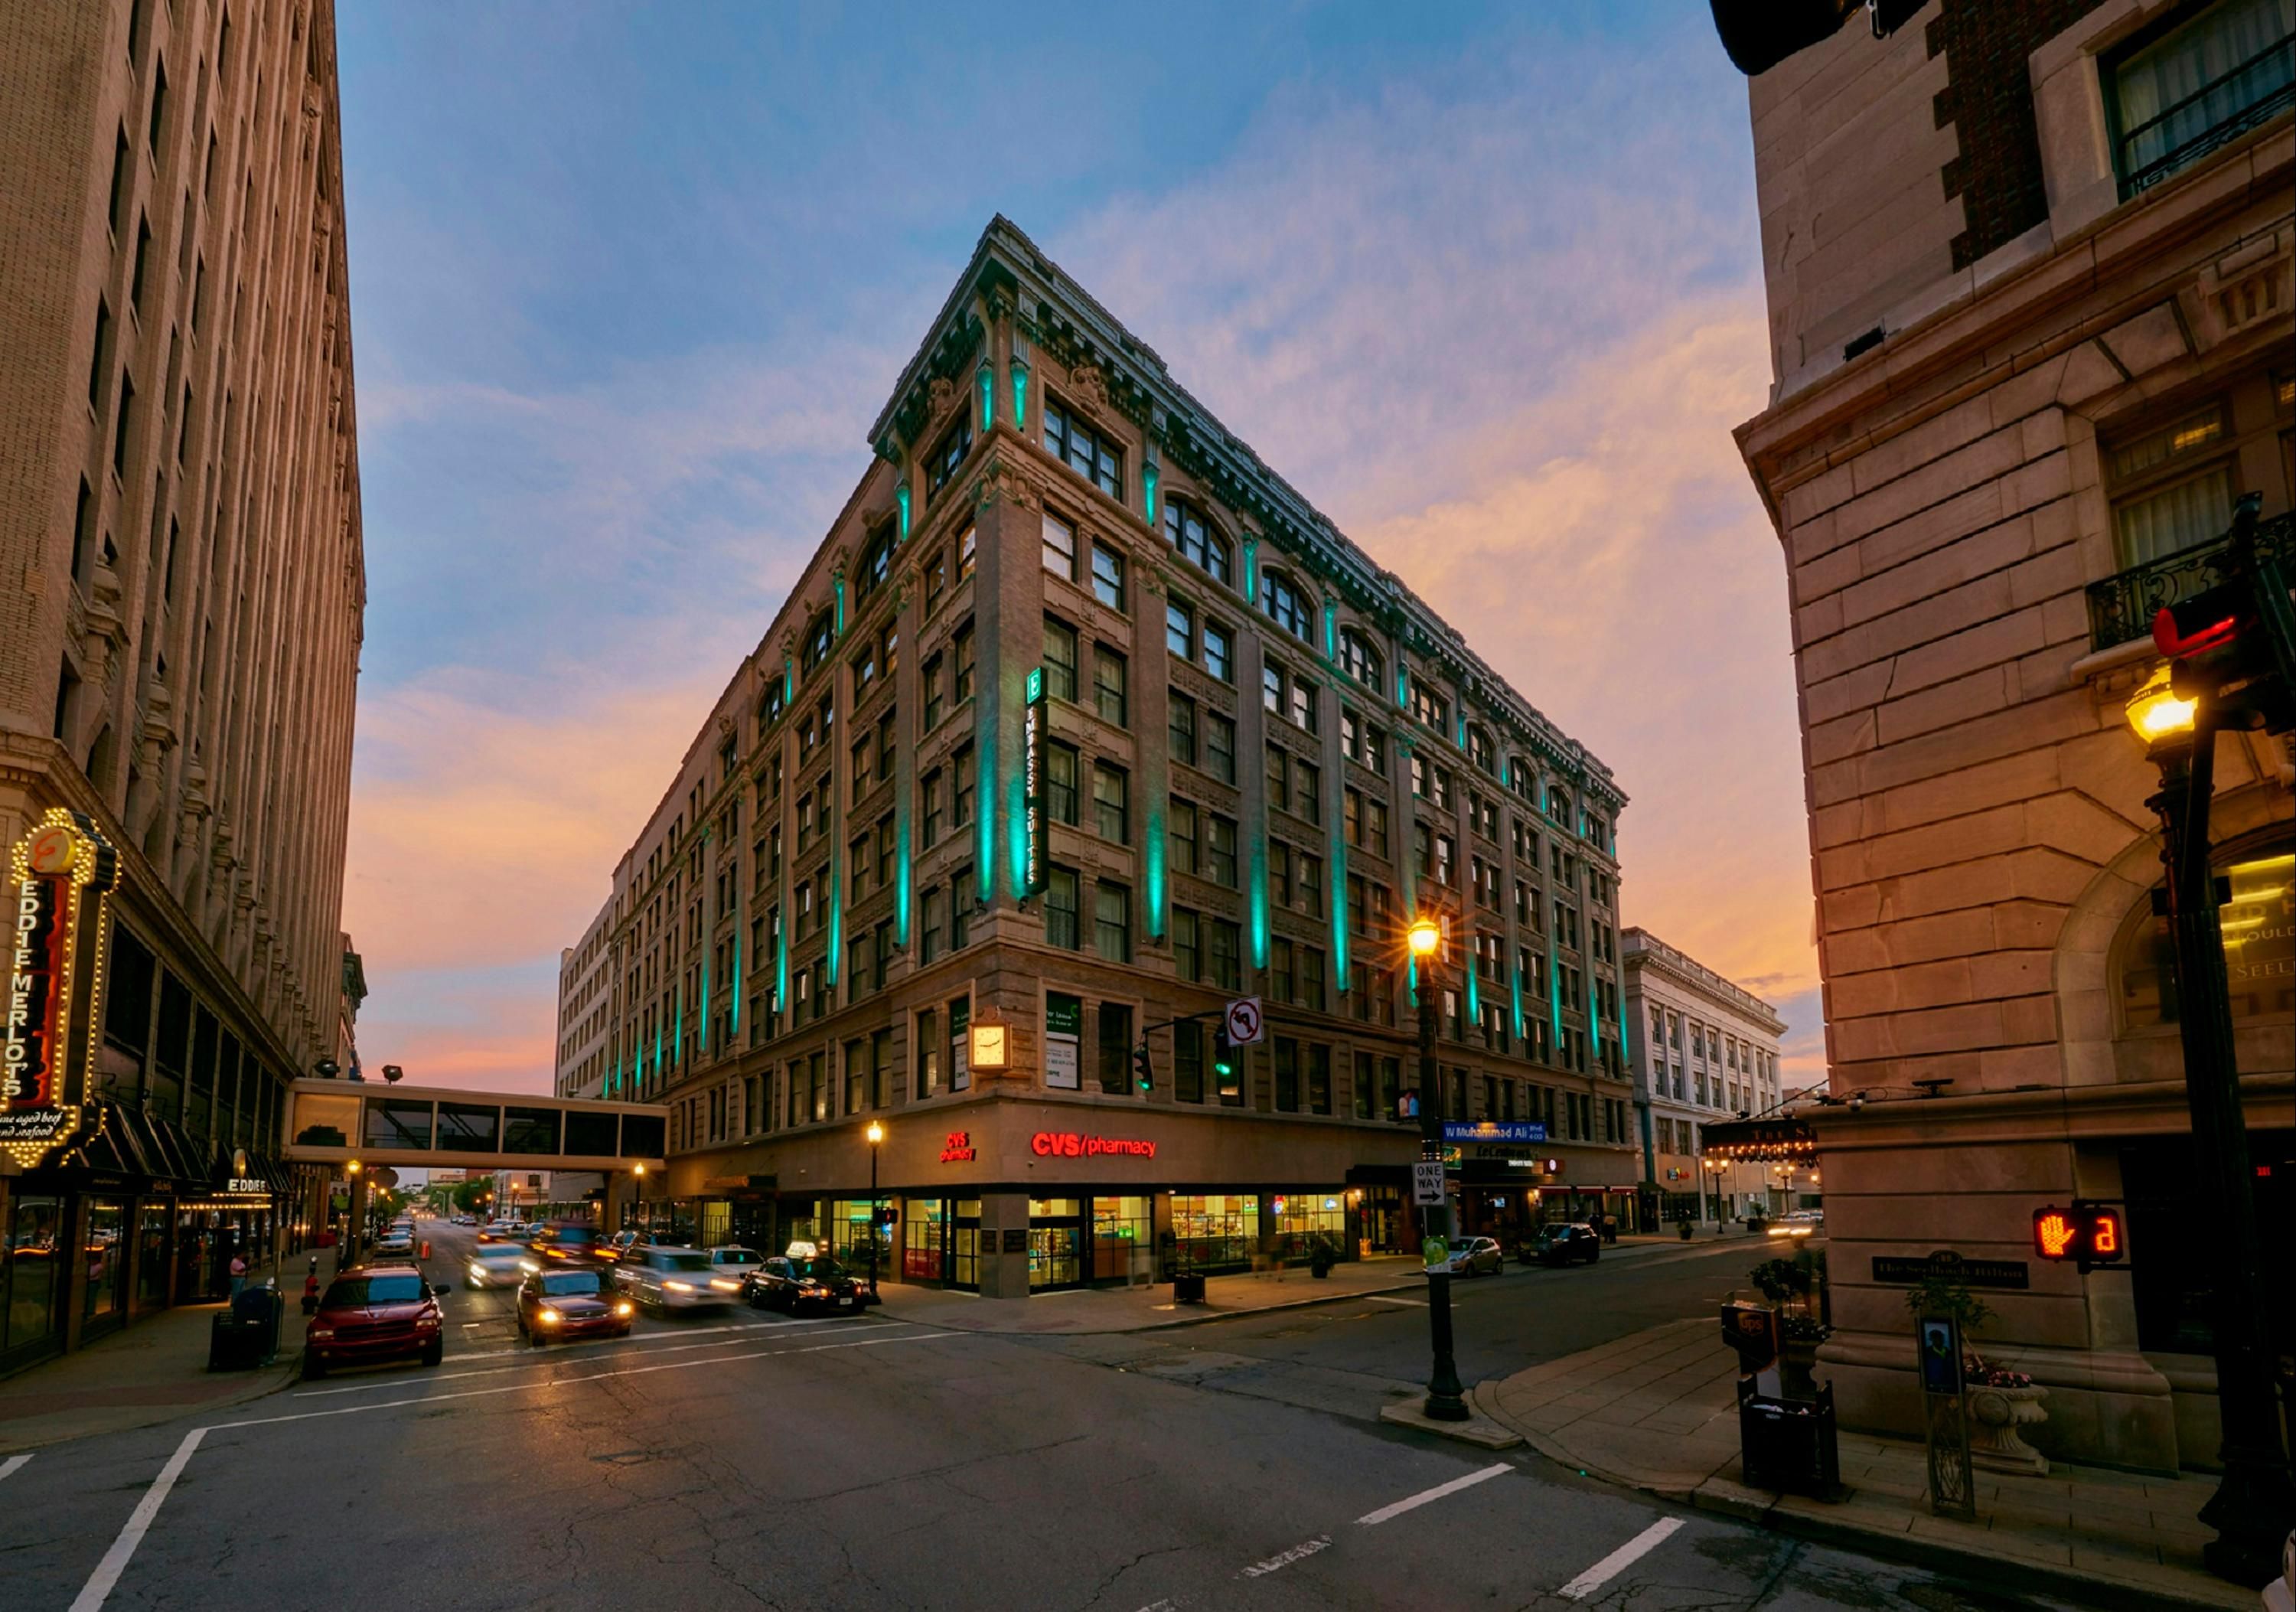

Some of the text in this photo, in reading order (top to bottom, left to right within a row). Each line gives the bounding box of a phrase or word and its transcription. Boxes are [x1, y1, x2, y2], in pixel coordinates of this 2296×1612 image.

[1030, 674, 1039, 697] E
[1026, 706, 1036, 798] EMBASSY
[1027, 806, 1037, 885] SUITES
[15, 880, 39, 965] EDDIE
[2236, 960, 2294, 979] SEEL
[5, 974, 33, 1096] MERLOT'S
[16, 1111, 41, 1126] aged
[41, 1111, 63, 1125] beef
[15, 1125, 54, 1139] seafood
[947, 1132, 967, 1147] CVS
[1446, 1127, 1527, 1138] W Muhammad Ali
[1032, 1132, 1155, 1158] CVS/pharmacy
[1417, 1165, 1441, 1176] ONE
[228, 1179, 266, 1192] EDDIE
[1418, 1177, 1442, 1189] WAY
